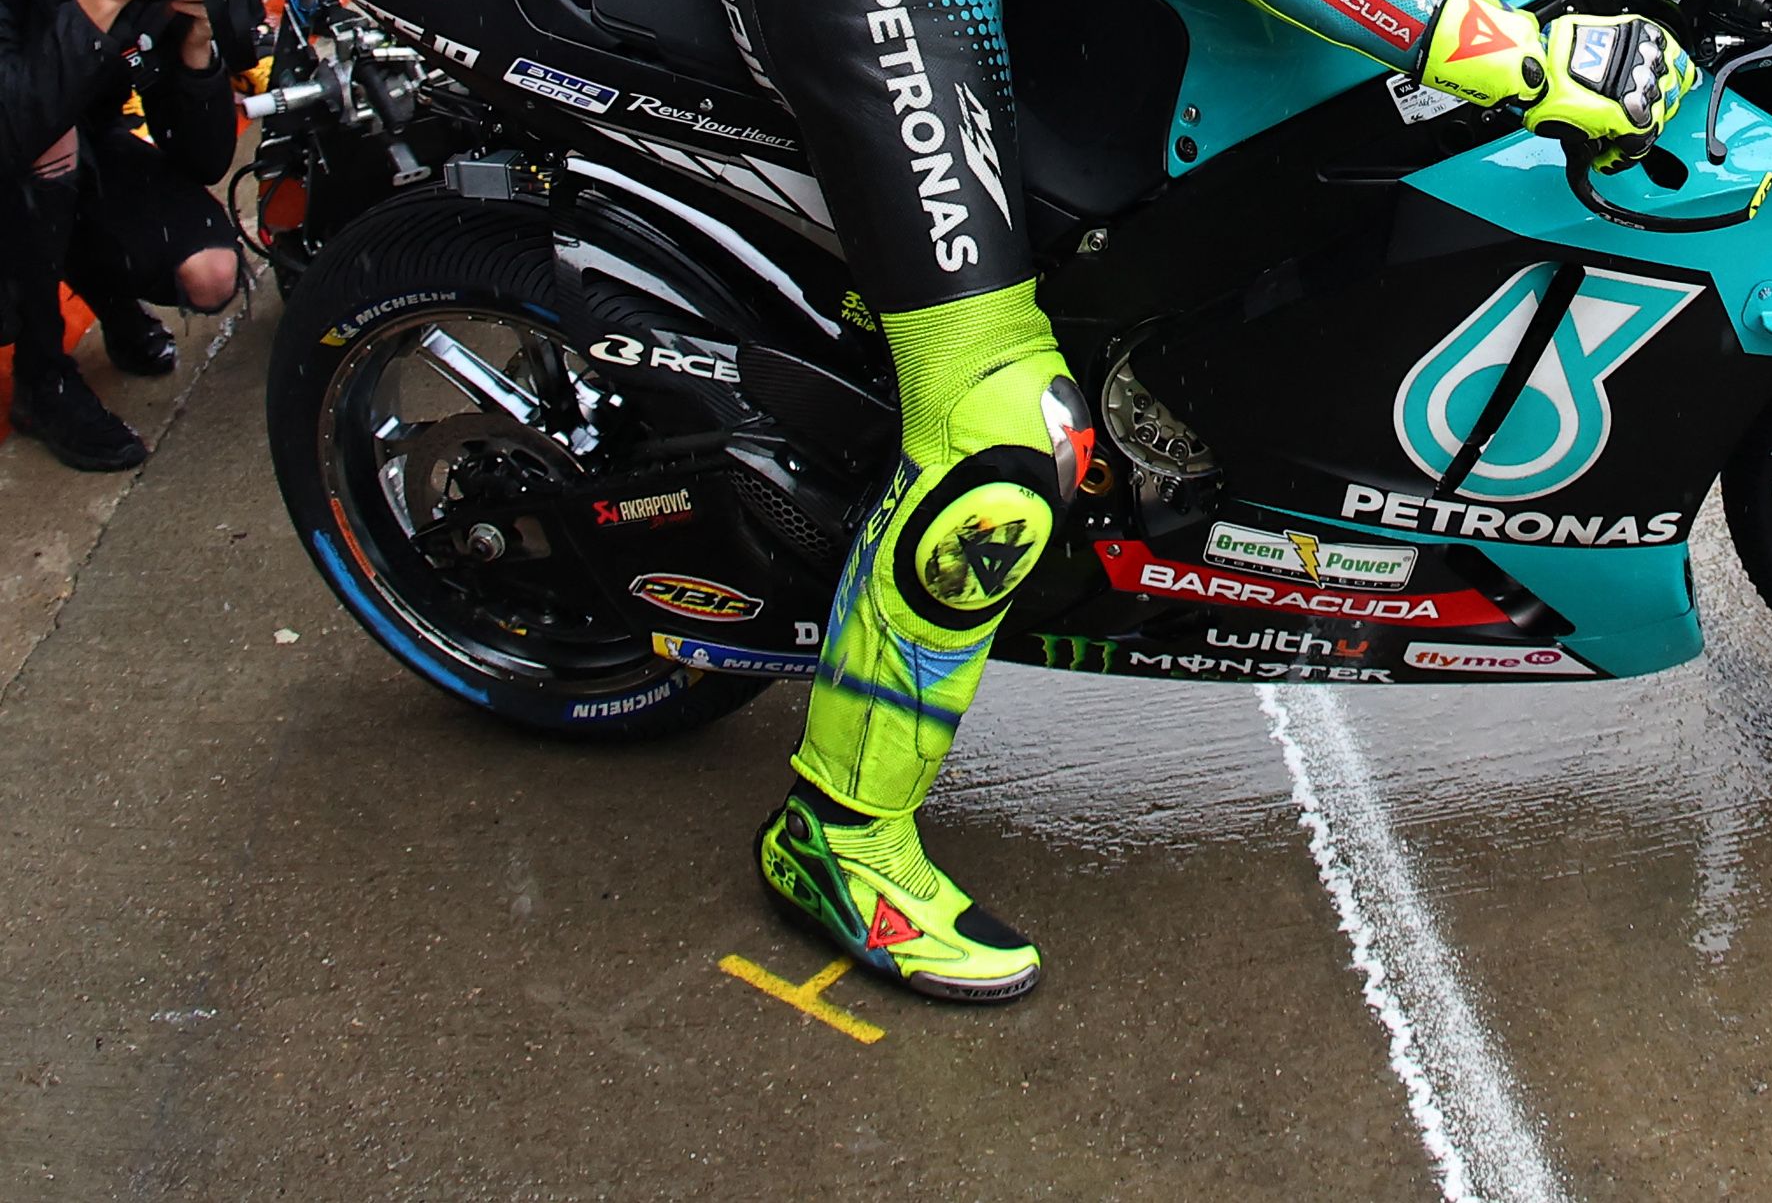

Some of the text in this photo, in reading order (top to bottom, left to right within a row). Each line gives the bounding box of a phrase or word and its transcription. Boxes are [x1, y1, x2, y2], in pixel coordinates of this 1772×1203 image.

[520, 78, 592, 108] CORE
[527, 65, 602, 97] BLUE
[627, 93, 796, 148] Revs Your Heart
[355, 292, 456, 326] MICHELIN
[1340, 484, 1682, 545] PETRONAS
[1216, 534, 1401, 575] Green Power
[1140, 564, 1439, 619] BARRACUDA
[1130, 652, 1395, 683] MONSTER
[572, 682, 670, 718] MICHELIN
